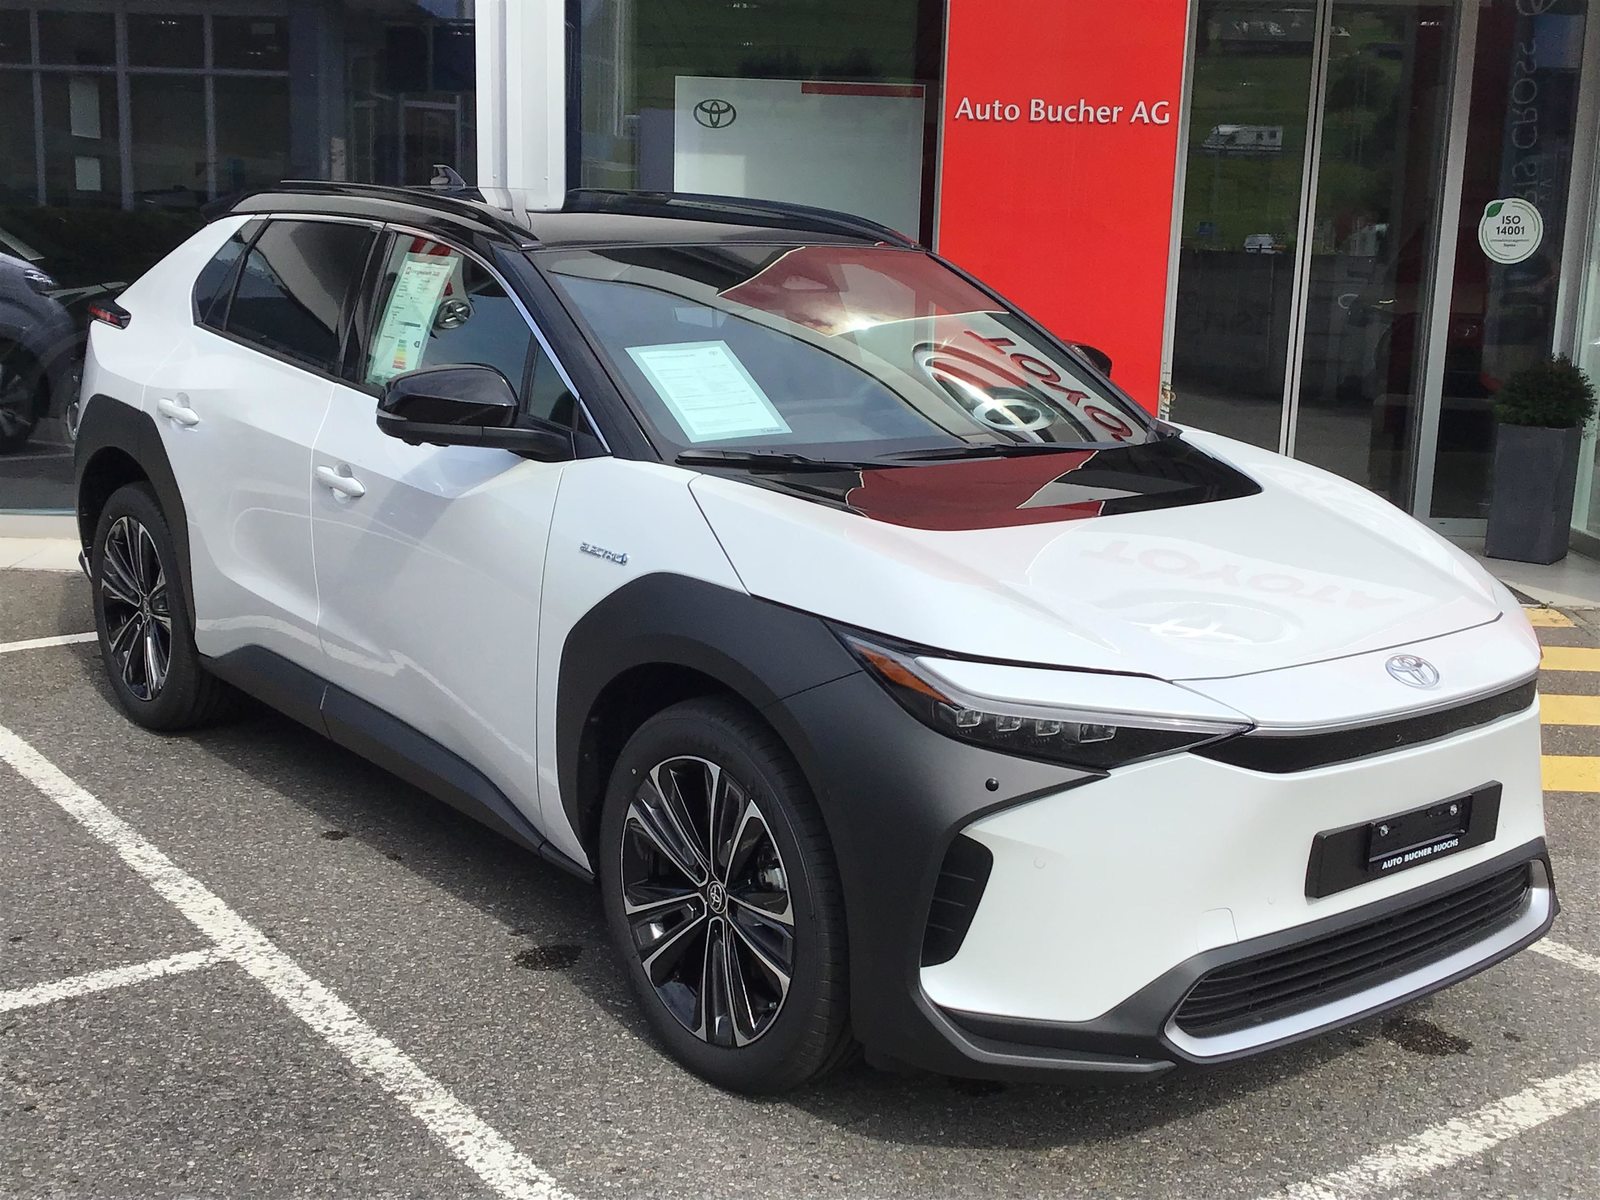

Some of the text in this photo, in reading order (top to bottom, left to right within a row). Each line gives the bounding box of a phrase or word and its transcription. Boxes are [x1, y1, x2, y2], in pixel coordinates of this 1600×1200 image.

[954, 97, 1170, 124] Auto Bucher AG
[1502, 215, 1521, 225] ISO
[1496, 226, 1525, 235] 14001
[1381, 838, 1459, 869] AUTO BUCHER BUOCHS
